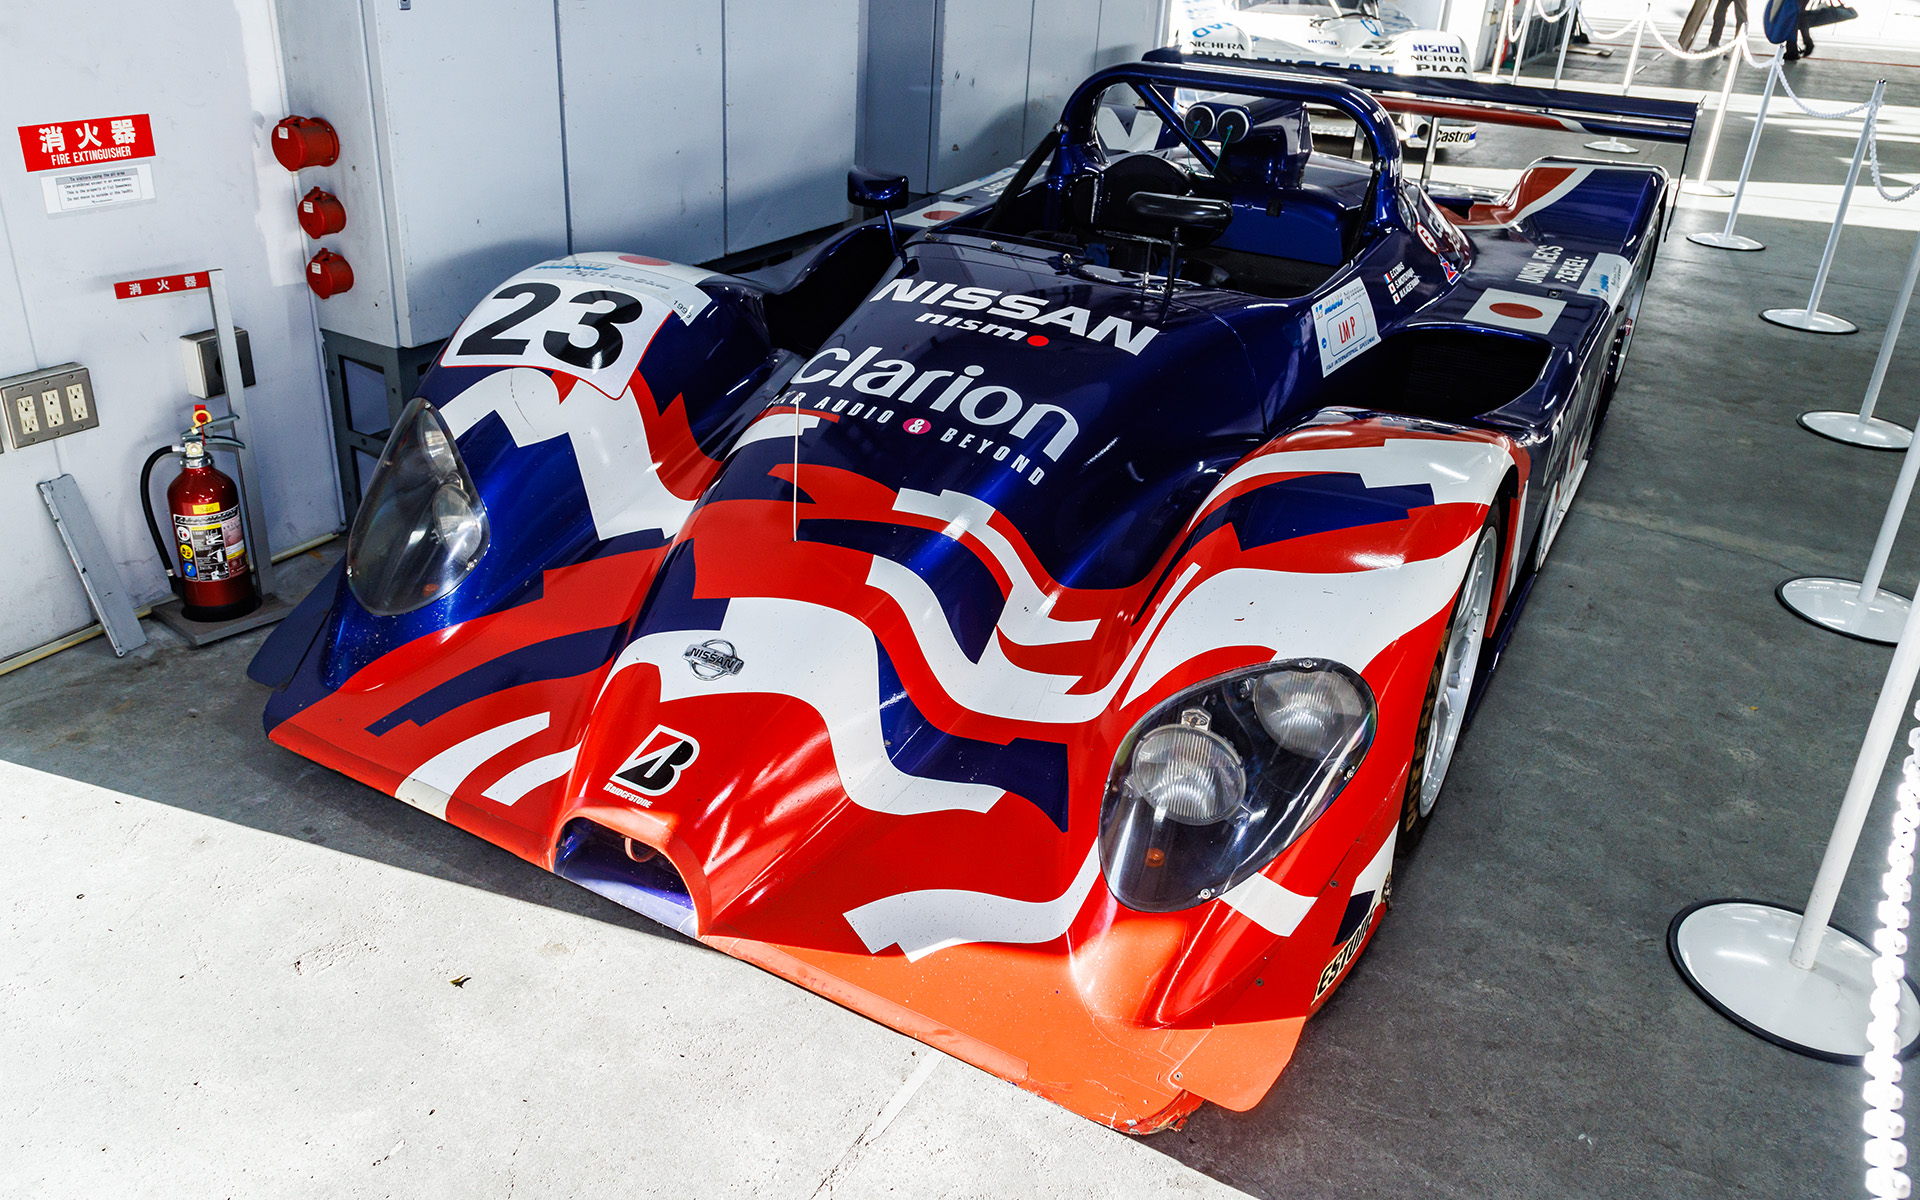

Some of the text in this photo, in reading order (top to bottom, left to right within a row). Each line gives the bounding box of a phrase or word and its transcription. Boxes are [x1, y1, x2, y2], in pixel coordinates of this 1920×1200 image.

[1413, 44, 1460, 53] NISMO
[1416, 64, 1467, 74] PIAA
[38, 119, 136, 153] 消火器
[51, 145, 132, 166] FIRE EXTINGUISHER
[129, 275, 197, 295] 消火器
[456, 283, 643, 370] 23
[869, 279, 1160, 356] NISSAN
[813, 396, 895, 424] AUDIO
[908, 418, 926, 434] &
[940, 427, 1045, 486] BEYOND
[690, 647, 735, 670] NISSAN
[603, 782, 653, 809] BRIDGESTONE
